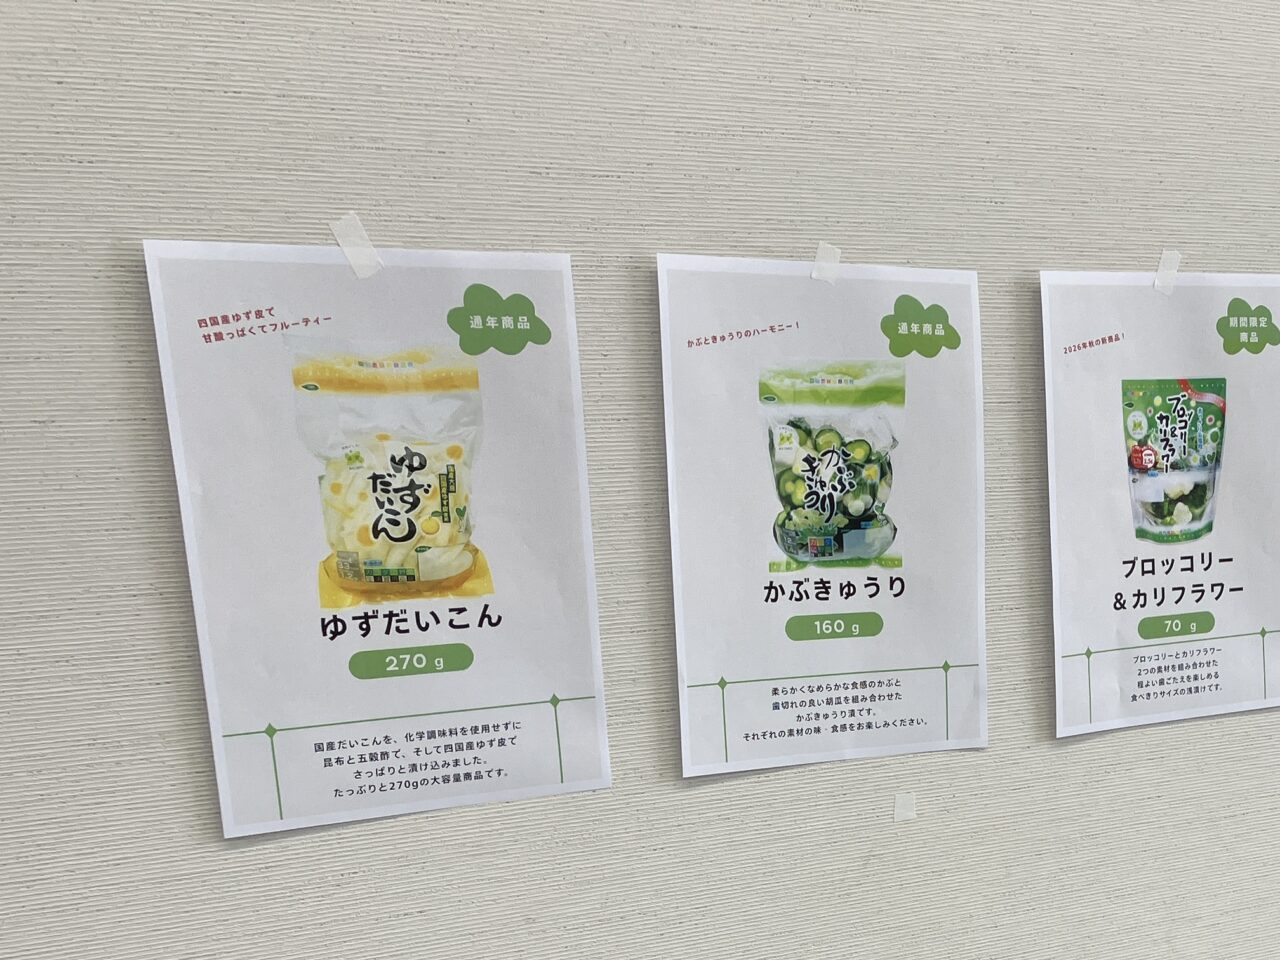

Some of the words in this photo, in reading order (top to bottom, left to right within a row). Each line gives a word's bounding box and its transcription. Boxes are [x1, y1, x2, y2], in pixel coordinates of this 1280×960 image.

[197, 306, 275, 329] 四国産ゆず皮で
[469, 314, 532, 331] 通年商品
[1229, 316, 1268, 328] 期間限定
[202, 316, 332, 344] 甘酸っぱくてフルーティー
[687, 321, 800, 348] かぶときゅうりのハーモニー！
[897, 322, 946, 336] 通年商品
[1239, 332, 1259, 343] 商品
[1122, 552, 1234, 579] ブロッコリー
[763, 575, 906, 604] かぶきゅうり
[320, 603, 503, 641] ゆずだいこん
[814, 619, 845, 635] 160
[851, 623, 860, 636] g
[1164, 619, 1181, 633] 70
[1190, 622, 1197, 633] g
[385, 653, 427, 671] 270
[434, 657, 444, 670] g
[1133, 646, 1222, 664] ブロッコリーとカリフラワー
[1137, 659, 1219, 677] 2つの素材を組み合わせた
[771, 678, 902, 697] 柔らかくなめらかな食感のかぶと
[1137, 671, 1219, 689] 程よい歯ごたえを楽しめる
[771, 692, 903, 711] 歯切れの良い胡瓜を組み合わせた
[1131, 683, 1223, 703] 食べきりサイズの浅漬けです。
[795, 707, 877, 723] かぶきゅうり漬です。
[313, 720, 522, 753] 国産だいこんを、化学調味料を使用せずに
[323, 736, 517, 768] 昆布と五穀酢で、そして四国産ゆず皮で
[353, 755, 488, 780] さっぱりと漬け込みました。
[334, 768, 508, 798] たっぷりと270gの大容量商品です。
